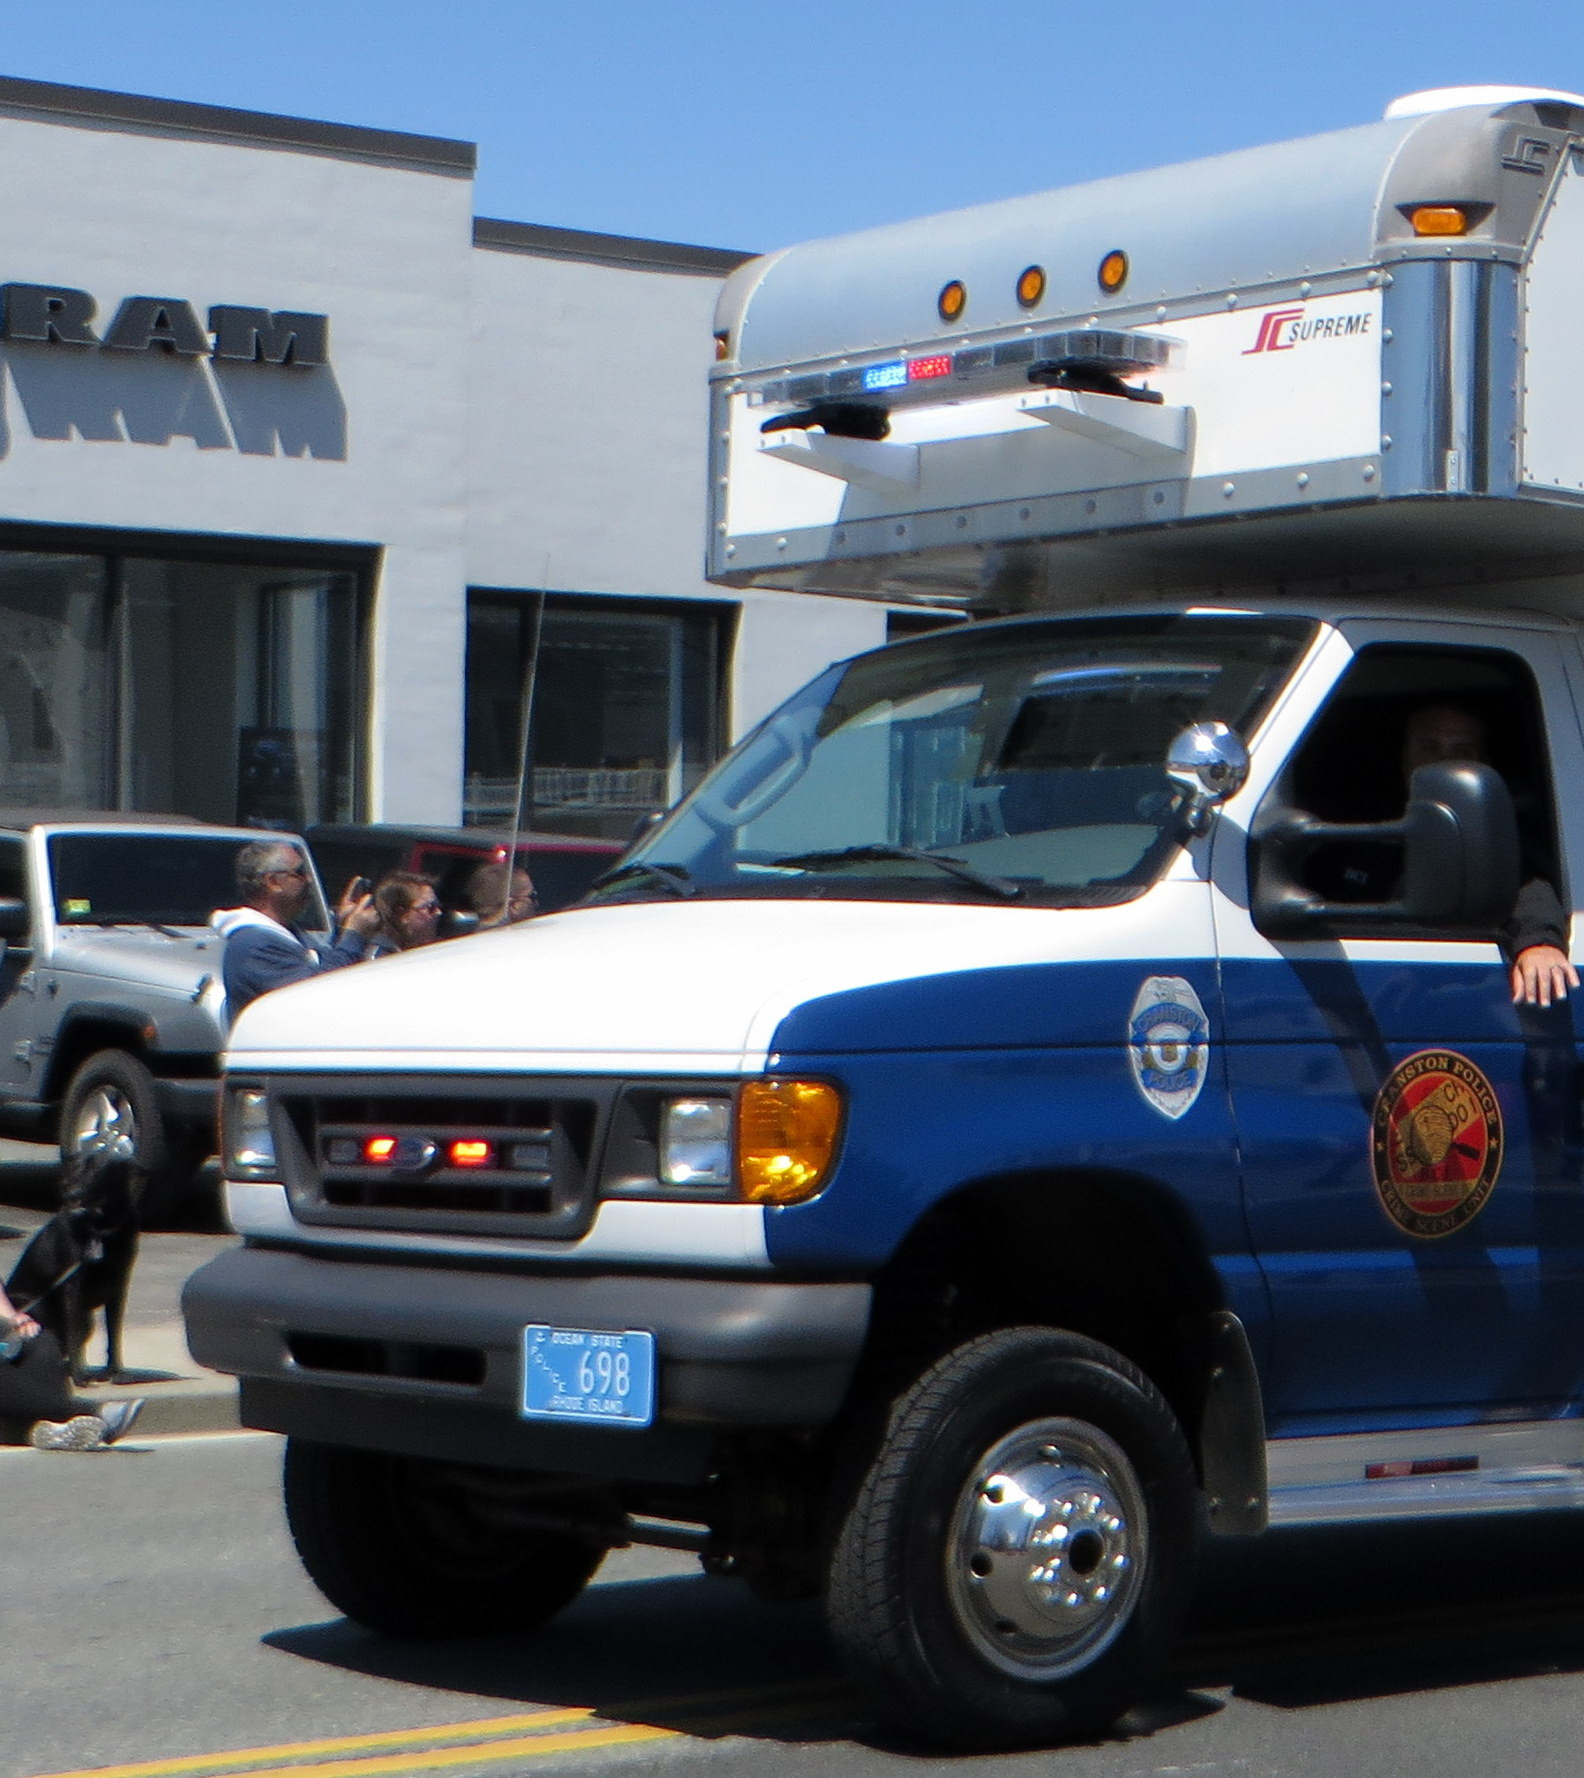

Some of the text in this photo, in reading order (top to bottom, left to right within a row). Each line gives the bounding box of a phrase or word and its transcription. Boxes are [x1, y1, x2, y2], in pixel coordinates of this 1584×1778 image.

[2, 281, 329, 366] RAM
[1289, 312, 1372, 342] SUPREME
[1453, 1061, 1498, 1125] POLICE
[590, 1334, 624, 1349] STATE
[530, 1345, 568, 1393] POLICE
[579, 1350, 631, 1397] 698
